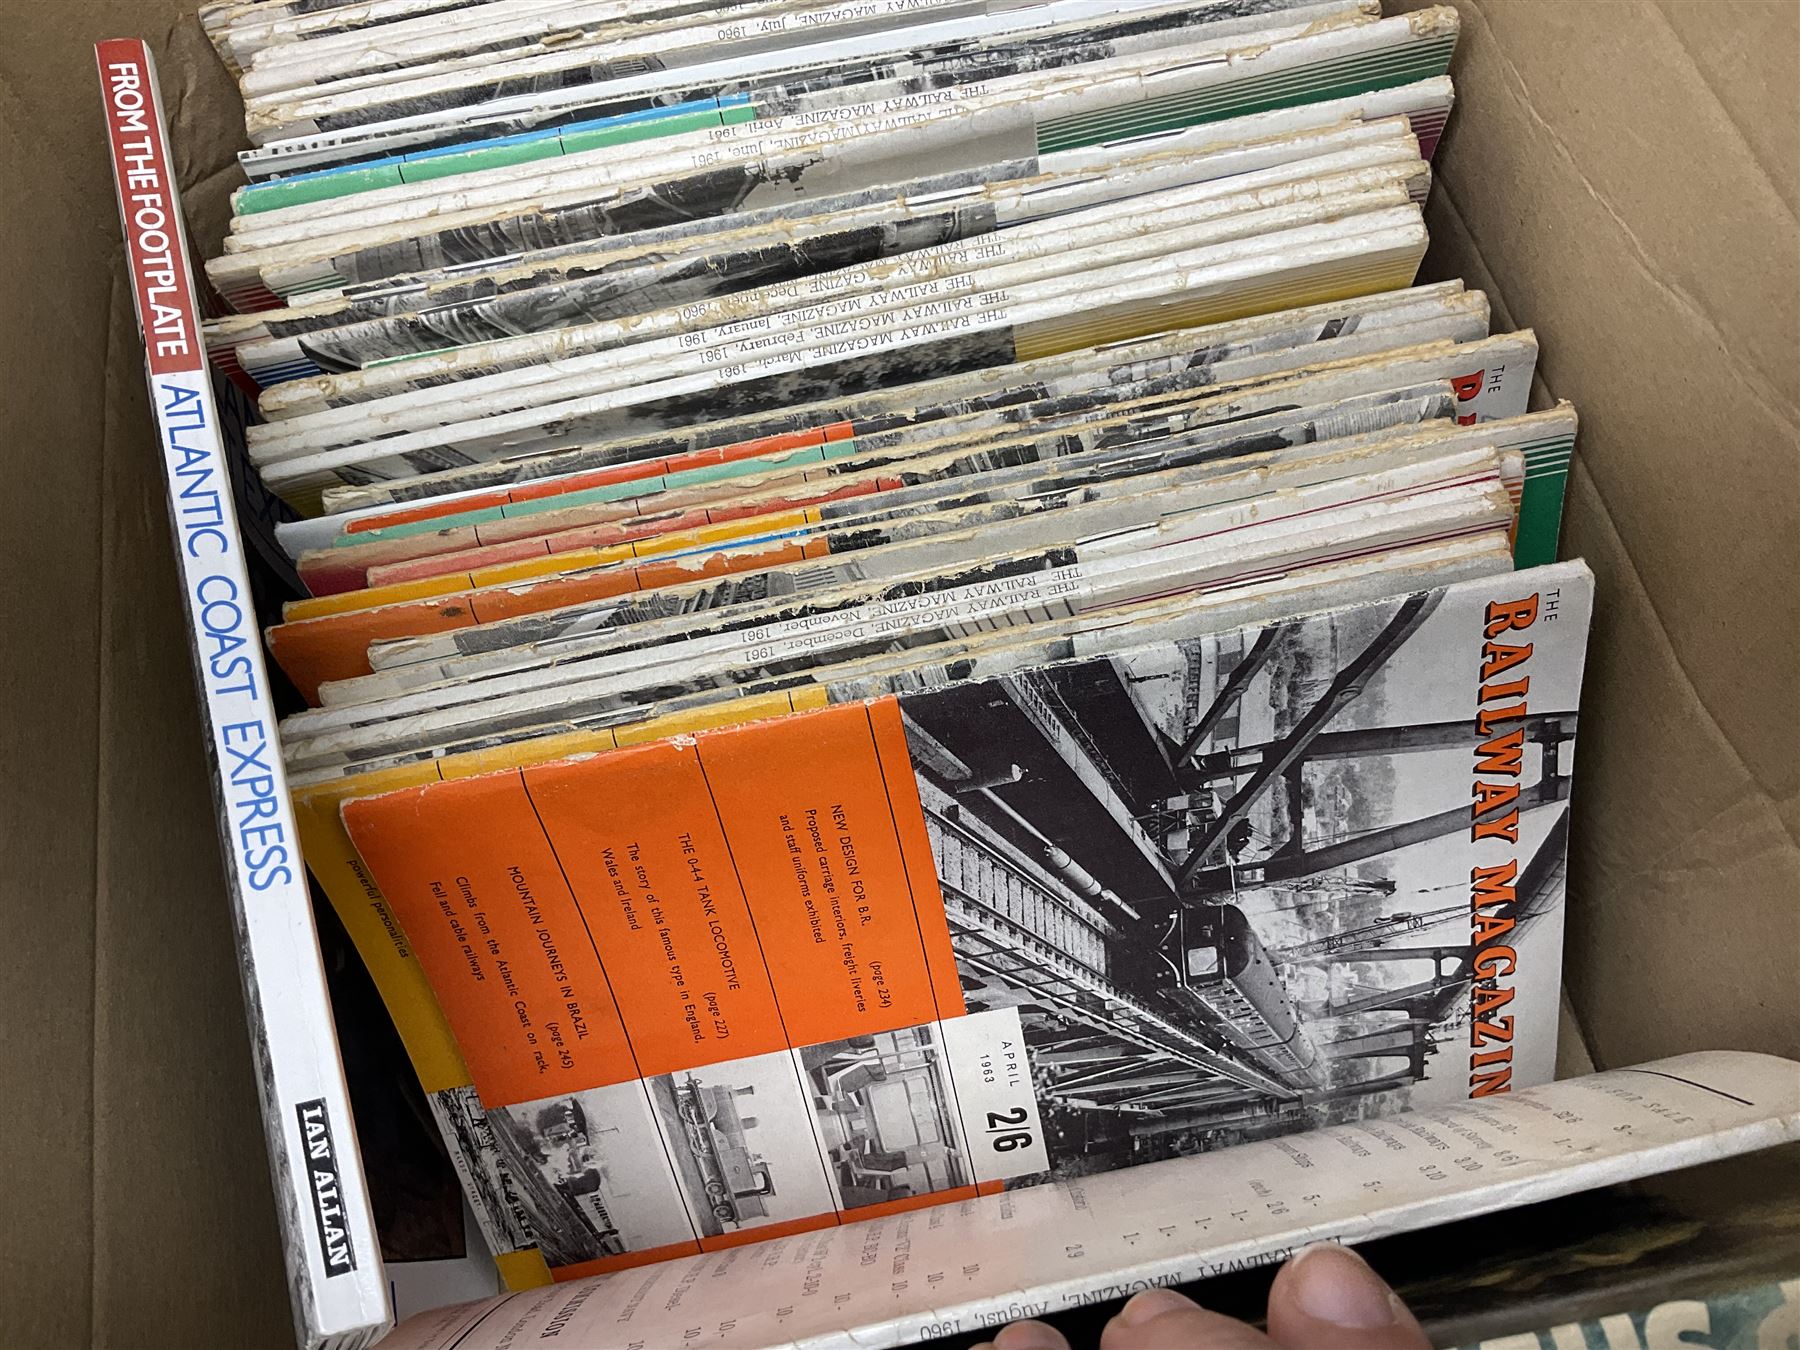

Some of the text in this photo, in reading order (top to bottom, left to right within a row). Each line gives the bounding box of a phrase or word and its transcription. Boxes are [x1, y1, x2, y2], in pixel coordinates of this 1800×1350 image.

[716, 25, 745, 40] 1960
[756, 16, 787, 33] July,
[882, 90, 952, 111] RAILWAY
[958, 84, 988, 98] THE
[707, 126, 736, 140] 1961
[691, 151, 720, 167] 1961
[728, 140, 764, 159] June,
[107, 58, 188, 360] FROM THE FOOTPLATE
[973, 242, 1005, 259] THE
[675, 274, 974, 348] THE RAILWAY MAGAZINE, January, 1961
[899, 295, 973, 321] RAILWAY
[978, 289, 1008, 305] THE
[898, 314, 970, 340] RAILWAY
[976, 307, 1006, 324] THE
[698, 347, 728, 364] 1961
[734, 328, 804, 355] February,
[717, 363, 746, 379] 1961
[1487, 364, 1505, 393] THE
[962, 573, 1036, 600] RAILWAY
[1050, 565, 1082, 582] THE
[744, 579, 1078, 661] THE RAILWAY MAGAZINE, December, 1961
[1543, 588, 1560, 621] THE
[161, 376, 293, 892] ATLANTIC COAST EXPRESS
[740, 626, 771, 643] 1961
[778, 607, 860, 636] November,
[1471, 592, 1539, 844] RAILWAY
[600, 847, 641, 931] Wales and Ireland
[778, 814, 825, 943] and staff uniforms exhibited
[346, 857, 410, 959] powerful personalities
[678, 832, 693, 855] THE
[696, 885, 716, 916] TANK
[708, 919, 739, 990] LOCOMOTIVE
[802, 809, 867, 1012] Proposed carriage interiors, freight liveries
[830, 804, 892, 1009] NEW DESIGN FOR B.R. (page 234)
[429, 879, 486, 982] Fell and cable railways
[626, 842, 705, 1044] The story of this famous type in England,
[507, 865, 589, 1040] MOUNTAIN JOURNEYS IN BRAZIL
[454, 874, 550, 1074] Climbs from the Atlantic Coast on rack,
[1470, 858, 1518, 1099] MAGAZIN
[703, 991, 729, 1040] (page 227)
[545, 1020, 575, 1071] (page 245)
[979, 1054, 994, 1083] 1963
[1001, 1040, 1020, 1086] APRIL
[985, 1106, 1033, 1153] 2/6
[302, 1105, 350, 1267] IAN ALLAN
[917, 1318, 963, 1340] 1960
